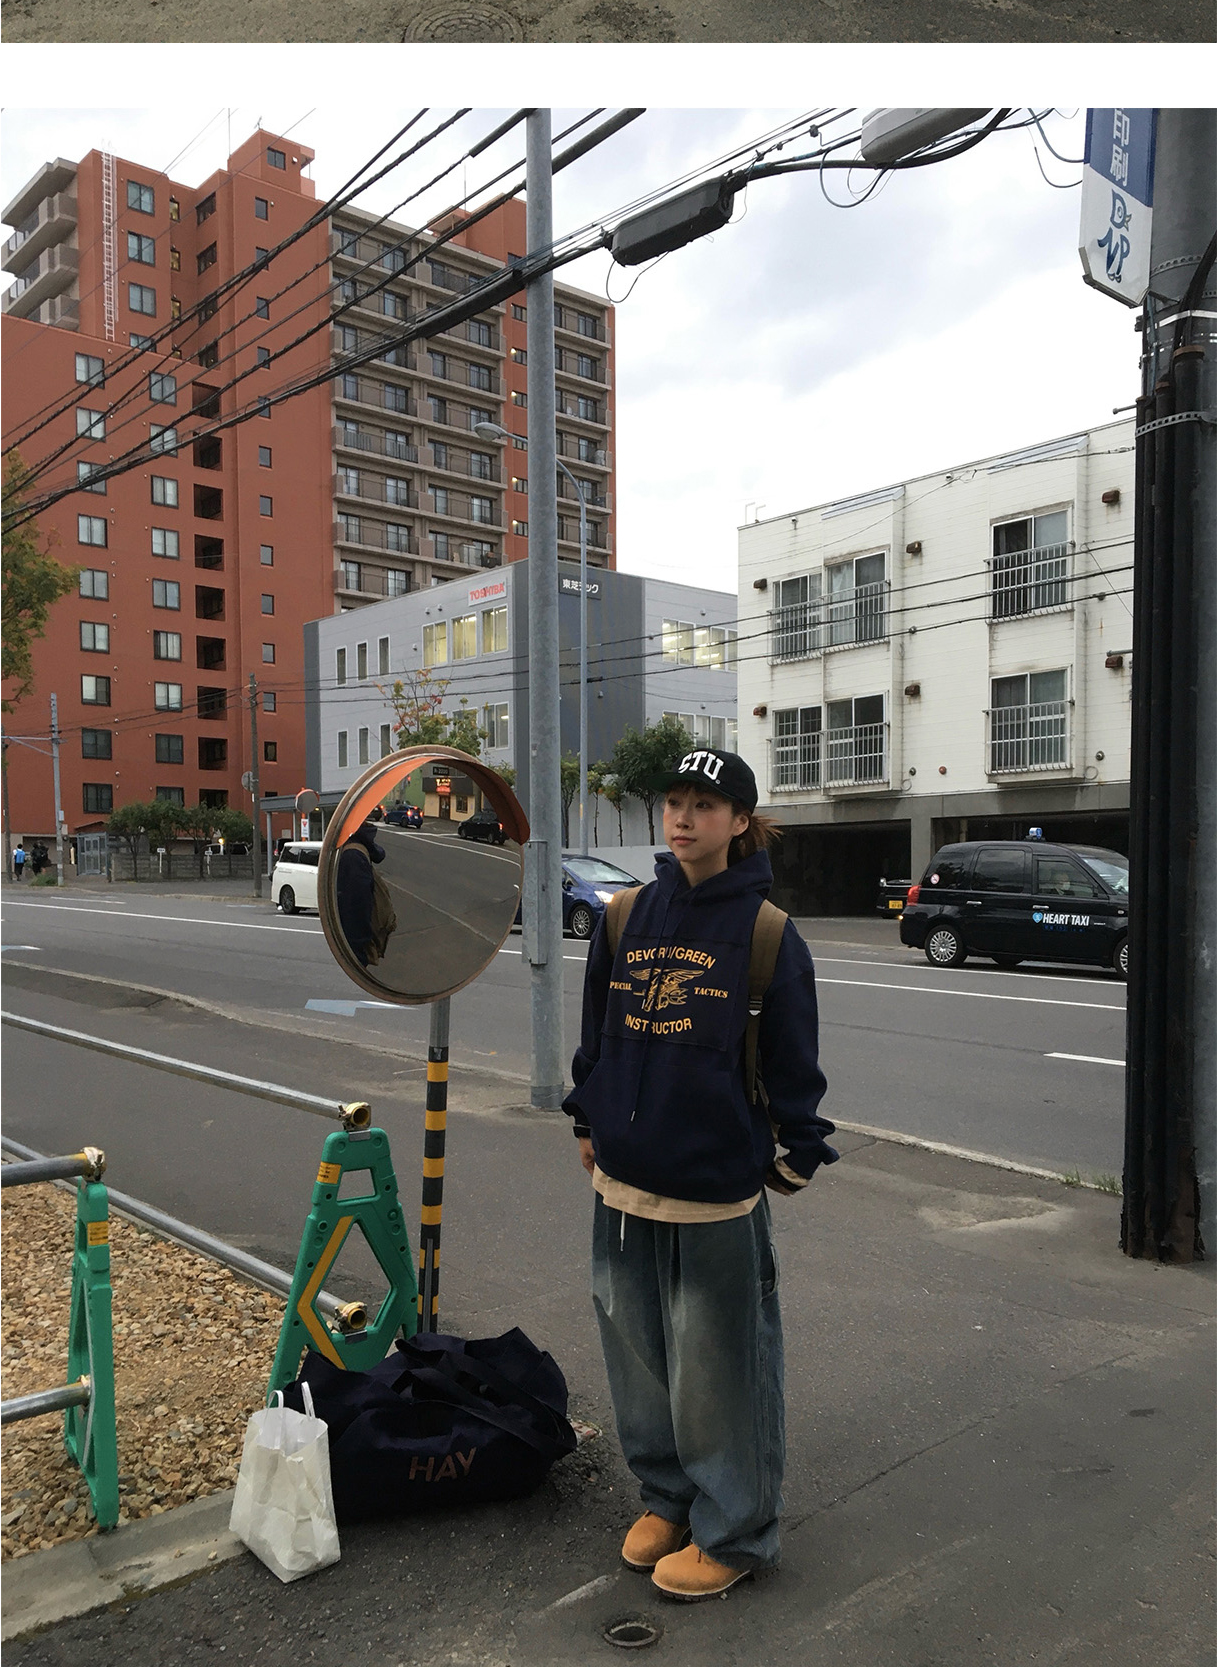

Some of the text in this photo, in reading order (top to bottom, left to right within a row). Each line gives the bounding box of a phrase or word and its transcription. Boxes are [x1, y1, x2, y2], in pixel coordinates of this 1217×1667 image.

[1110, 108, 1131, 187] 印刷
[469, 582, 505, 601] TOSHIBA
[678, 751, 725, 781] STU
[1042, 913, 1090, 926] HEART TAXI
[609, 981, 729, 999] PECIAL TACTICS
[408, 1447, 477, 1482] HAY
